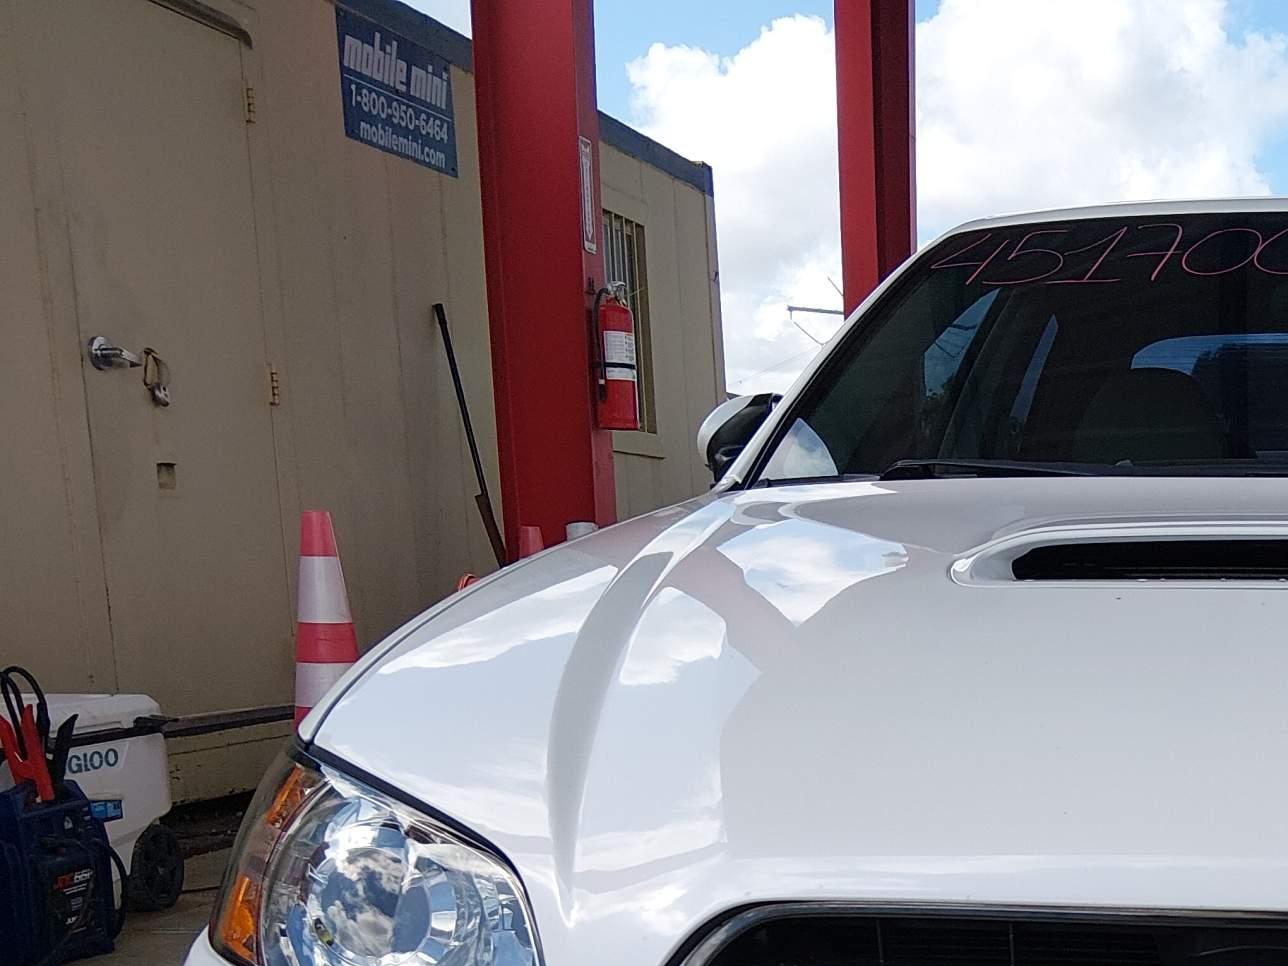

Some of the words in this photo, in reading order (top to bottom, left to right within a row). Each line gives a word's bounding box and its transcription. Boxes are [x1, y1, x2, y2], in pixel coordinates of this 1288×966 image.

[343, 31, 407, 92] mobile
[410, 64, 449, 110] mini
[350, 83, 448, 143] 1-800-950-6464
[360, 120, 446, 169] mobilemini.com
[67, 748, 119, 774] GLOO
